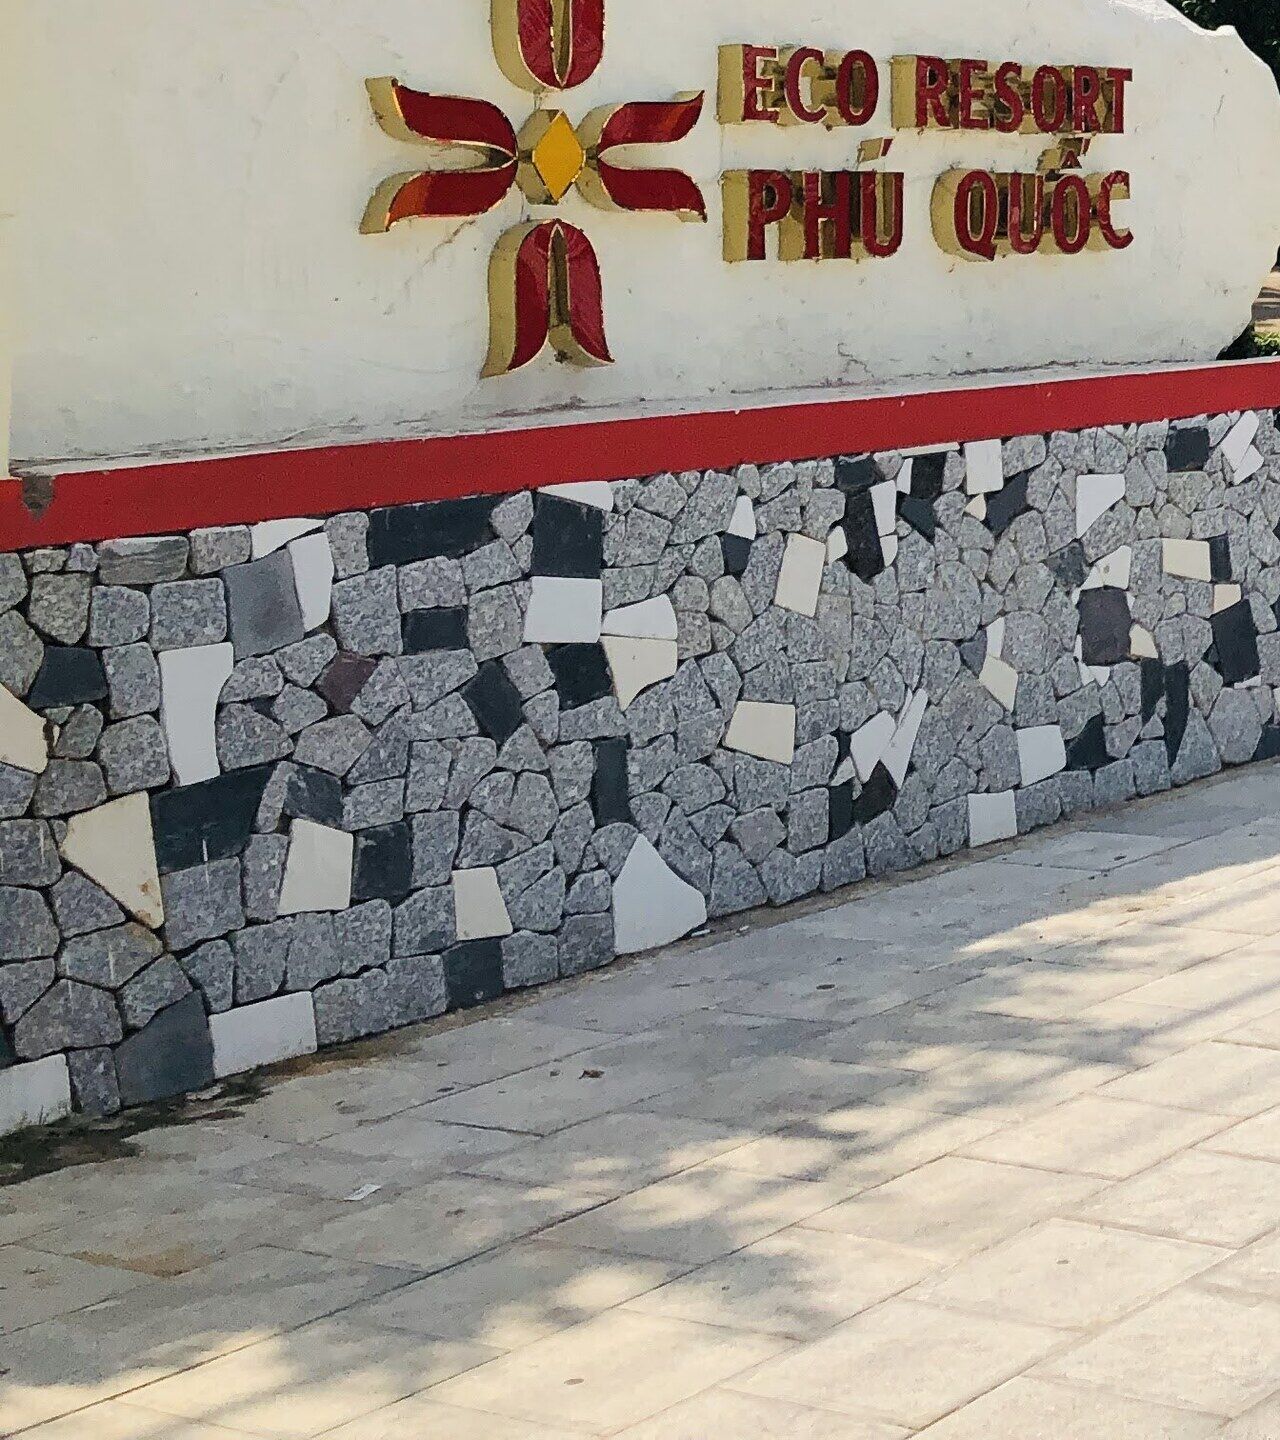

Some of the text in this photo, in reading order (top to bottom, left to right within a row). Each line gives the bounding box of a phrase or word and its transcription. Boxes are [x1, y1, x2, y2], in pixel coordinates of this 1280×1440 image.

[717, 44, 1133, 135] ECO RESORT
[721, 136, 1134, 262] PHÚ QUỐC
